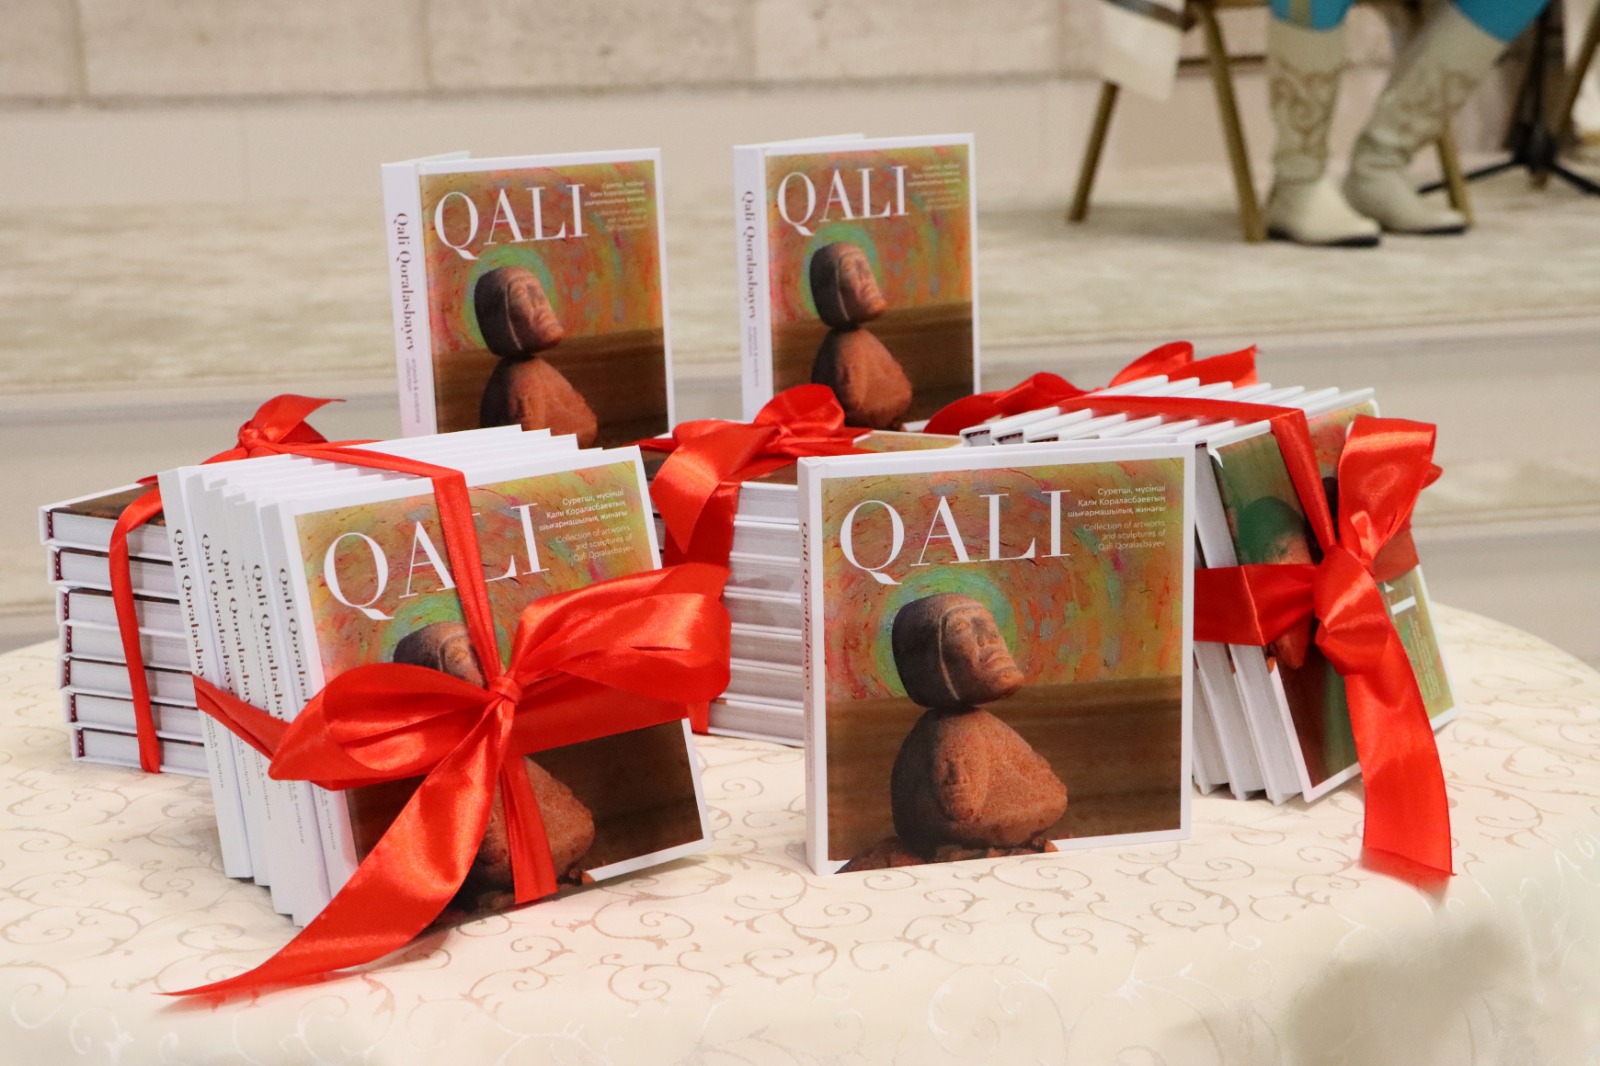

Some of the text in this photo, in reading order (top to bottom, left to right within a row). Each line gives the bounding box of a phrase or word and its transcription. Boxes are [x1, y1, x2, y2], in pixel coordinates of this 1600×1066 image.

[434, 184, 588, 261] QALI
[742, 190, 756, 222] Qali
[777, 165, 910, 236] QALI
[393, 212, 416, 351] Qali Qoralasbayev
[743, 226, 758, 319] Qoralasbayev
[1084, 523, 1122, 532] Collection
[1134, 520, 1166, 528] artworks
[1098, 487, 1133, 496] Суретші,
[202, 533, 215, 574] Qali
[556, 532, 592, 544] Collection
[840, 490, 1071, 585] QALI
[1118, 531, 1156, 541] sculptures
[174, 528, 205, 677] Qali Qoralasbay
[278, 568, 294, 610] Qali
[220, 549, 251, 704] Qali Qoralasbay
[252, 564, 268, 606] Qali
[260, 614, 284, 721] Qoralasba
